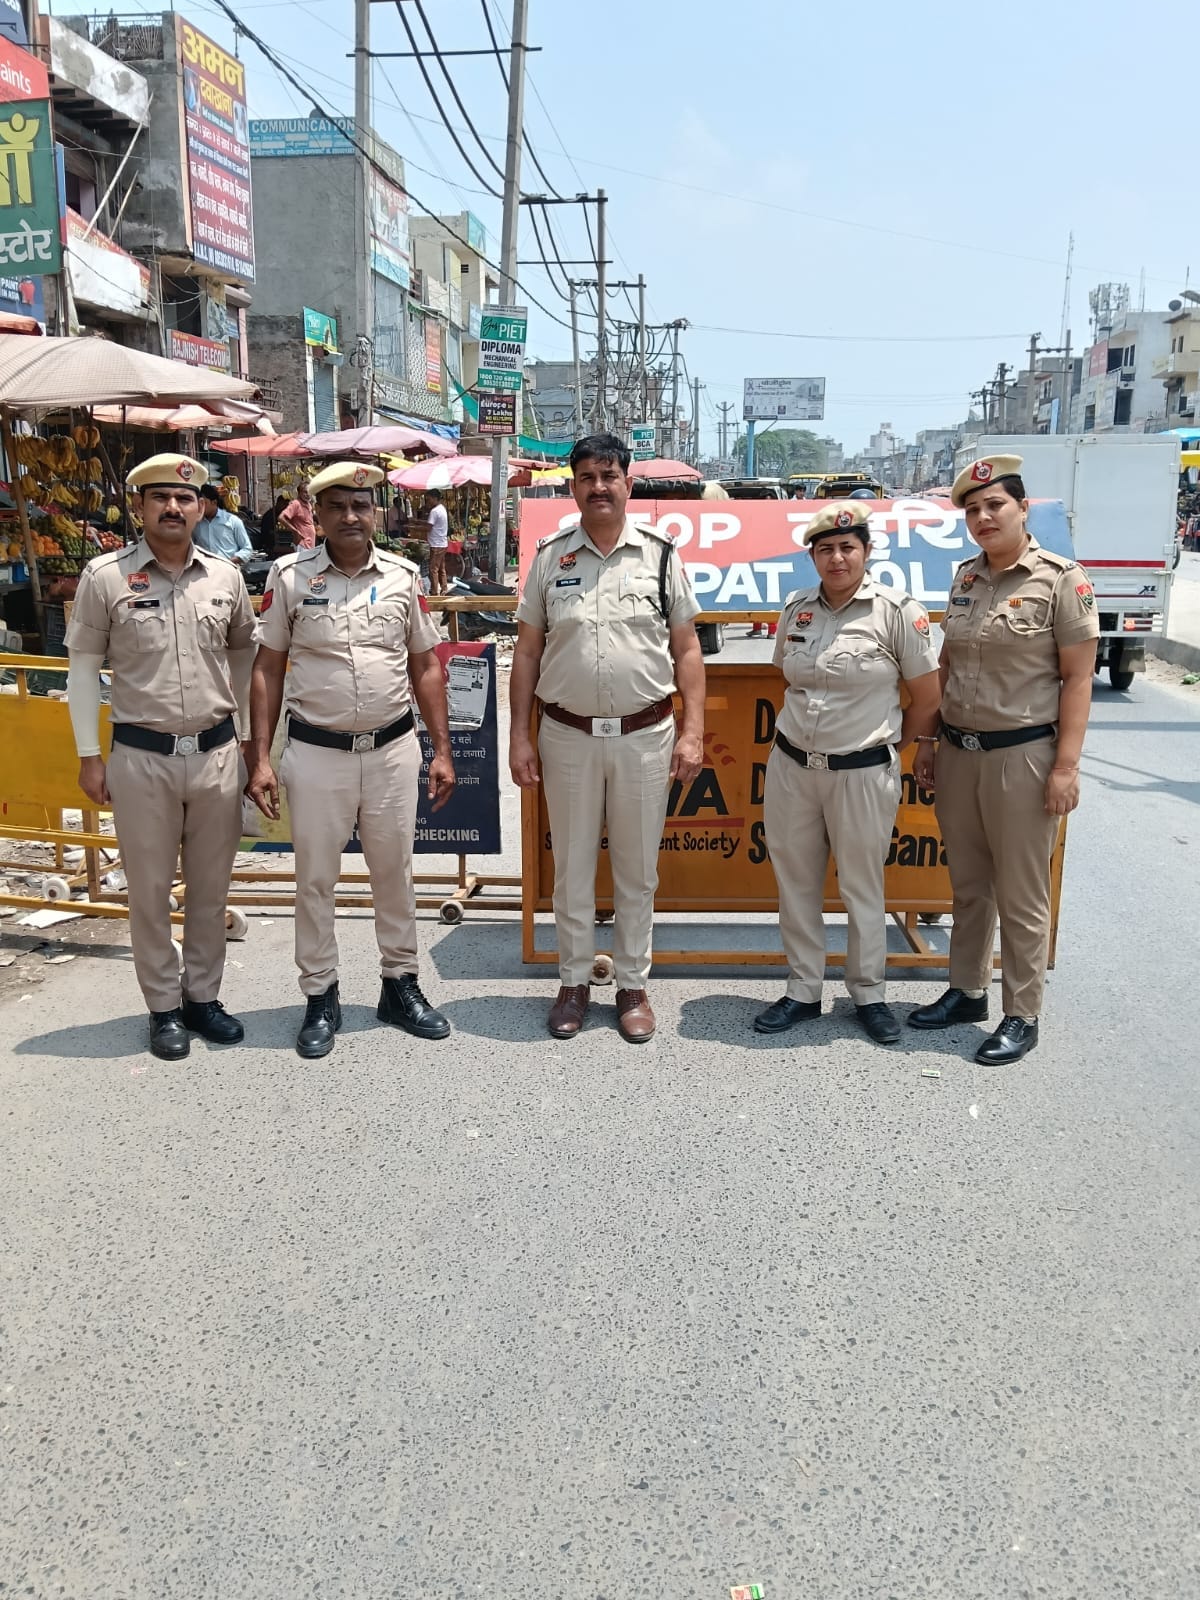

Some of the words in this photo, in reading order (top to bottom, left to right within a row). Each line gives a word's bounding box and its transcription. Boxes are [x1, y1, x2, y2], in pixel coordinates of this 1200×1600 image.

[499, 323, 526, 341] PIET
[173, 338, 199, 360] RAJNISH
[481, 341, 522, 356] DIPLOMA
[480, 399, 507, 410] Europe
[637, 440, 651, 448] BCA
[414, 829, 480, 841] CHECKING
[683, 831, 741, 859] Society
